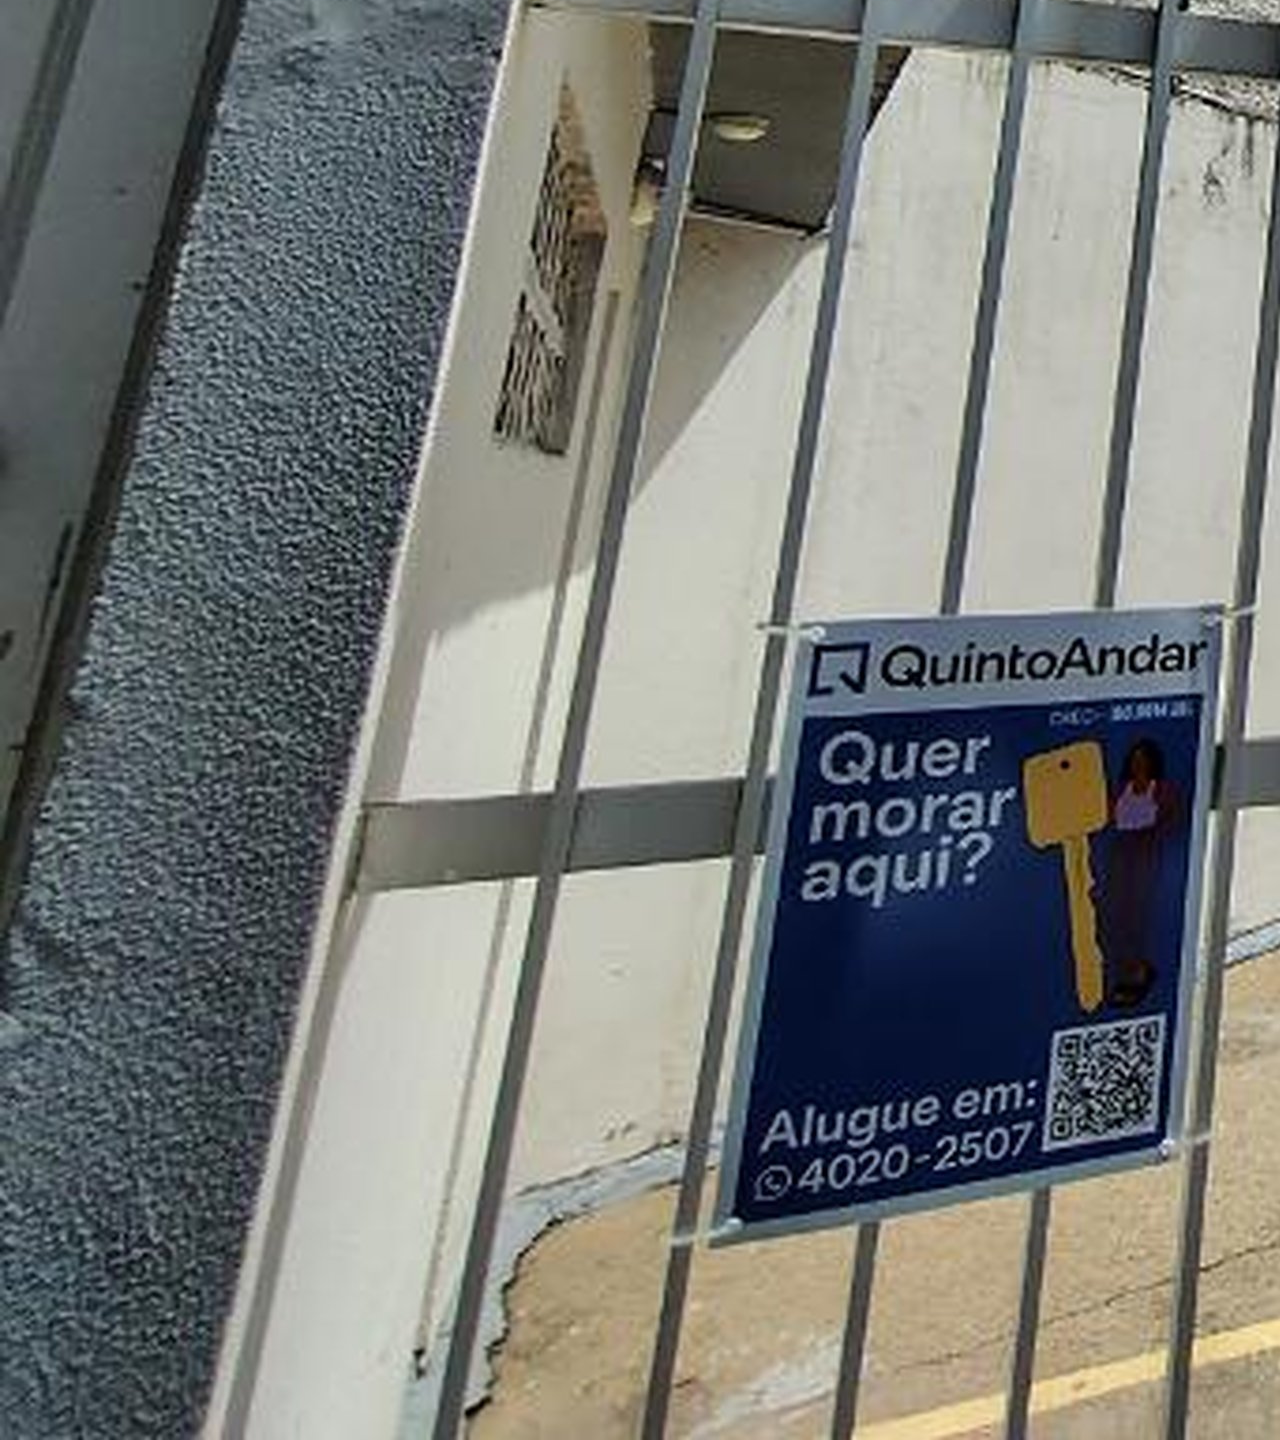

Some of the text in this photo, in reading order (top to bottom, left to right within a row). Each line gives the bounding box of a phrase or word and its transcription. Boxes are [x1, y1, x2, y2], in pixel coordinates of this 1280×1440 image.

[880, 633, 1208, 690] QuintoAndar
[818, 730, 992, 786] Quer
[808, 785, 1017, 844] morar
[800, 831, 994, 909] aqui?
[759, 1078, 1038, 1154] Alugue em:
[798, 1121, 1035, 1194] 4020-2507
